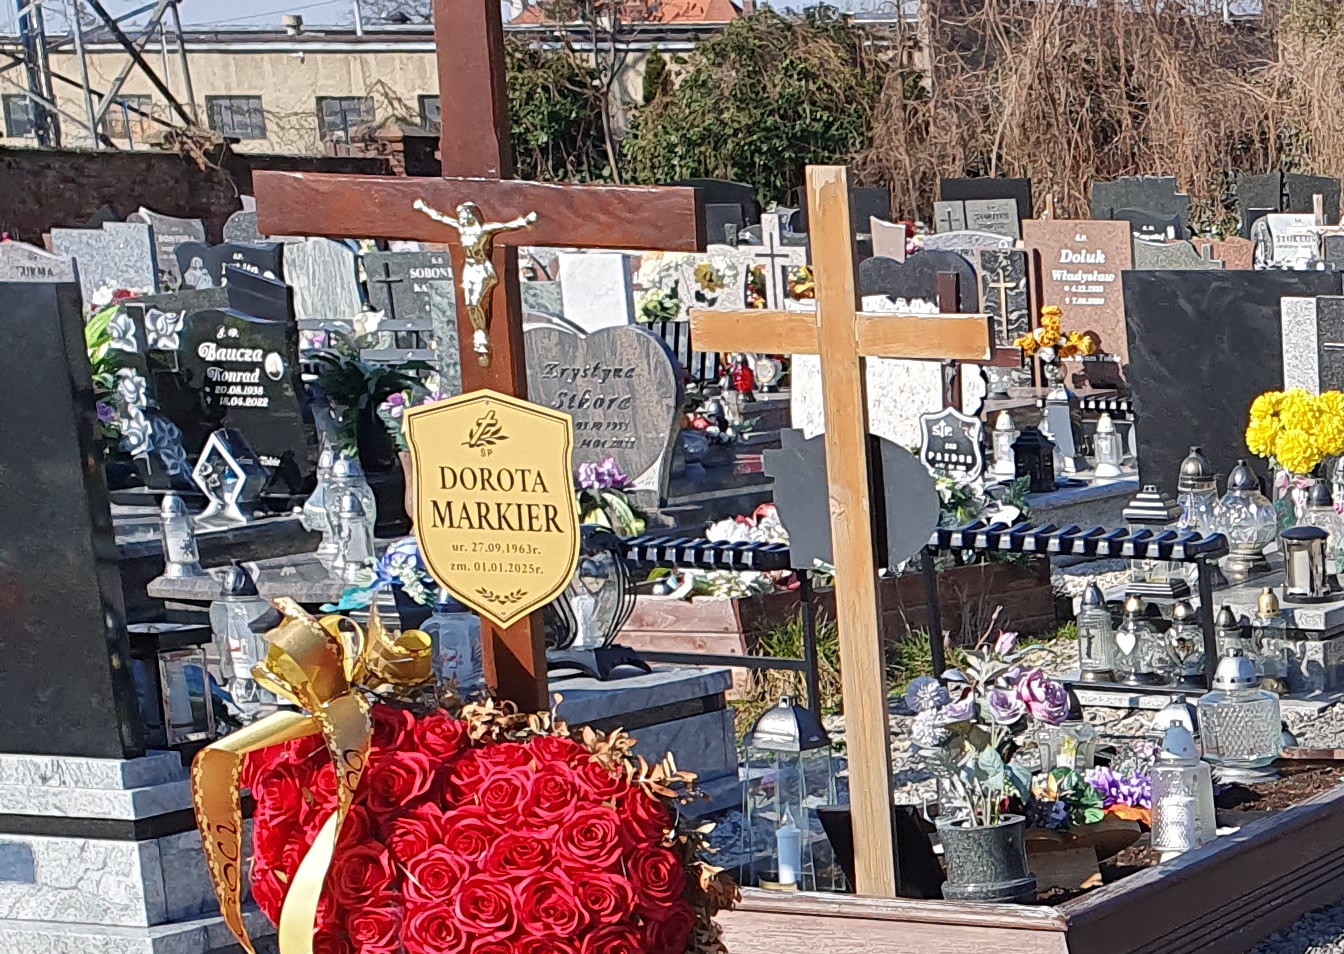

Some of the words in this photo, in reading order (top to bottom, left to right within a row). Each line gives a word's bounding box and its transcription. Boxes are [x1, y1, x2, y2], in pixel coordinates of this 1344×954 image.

[437, 465, 550, 494] DOROTA
[430, 499, 565, 534] MARKIER
[451, 543, 468, 553] ur.
[471, 541, 542, 555] 27.09.1963r.
[450, 562, 471, 573] zm.
[473, 561, 545, 575] 01.01.2025r.
